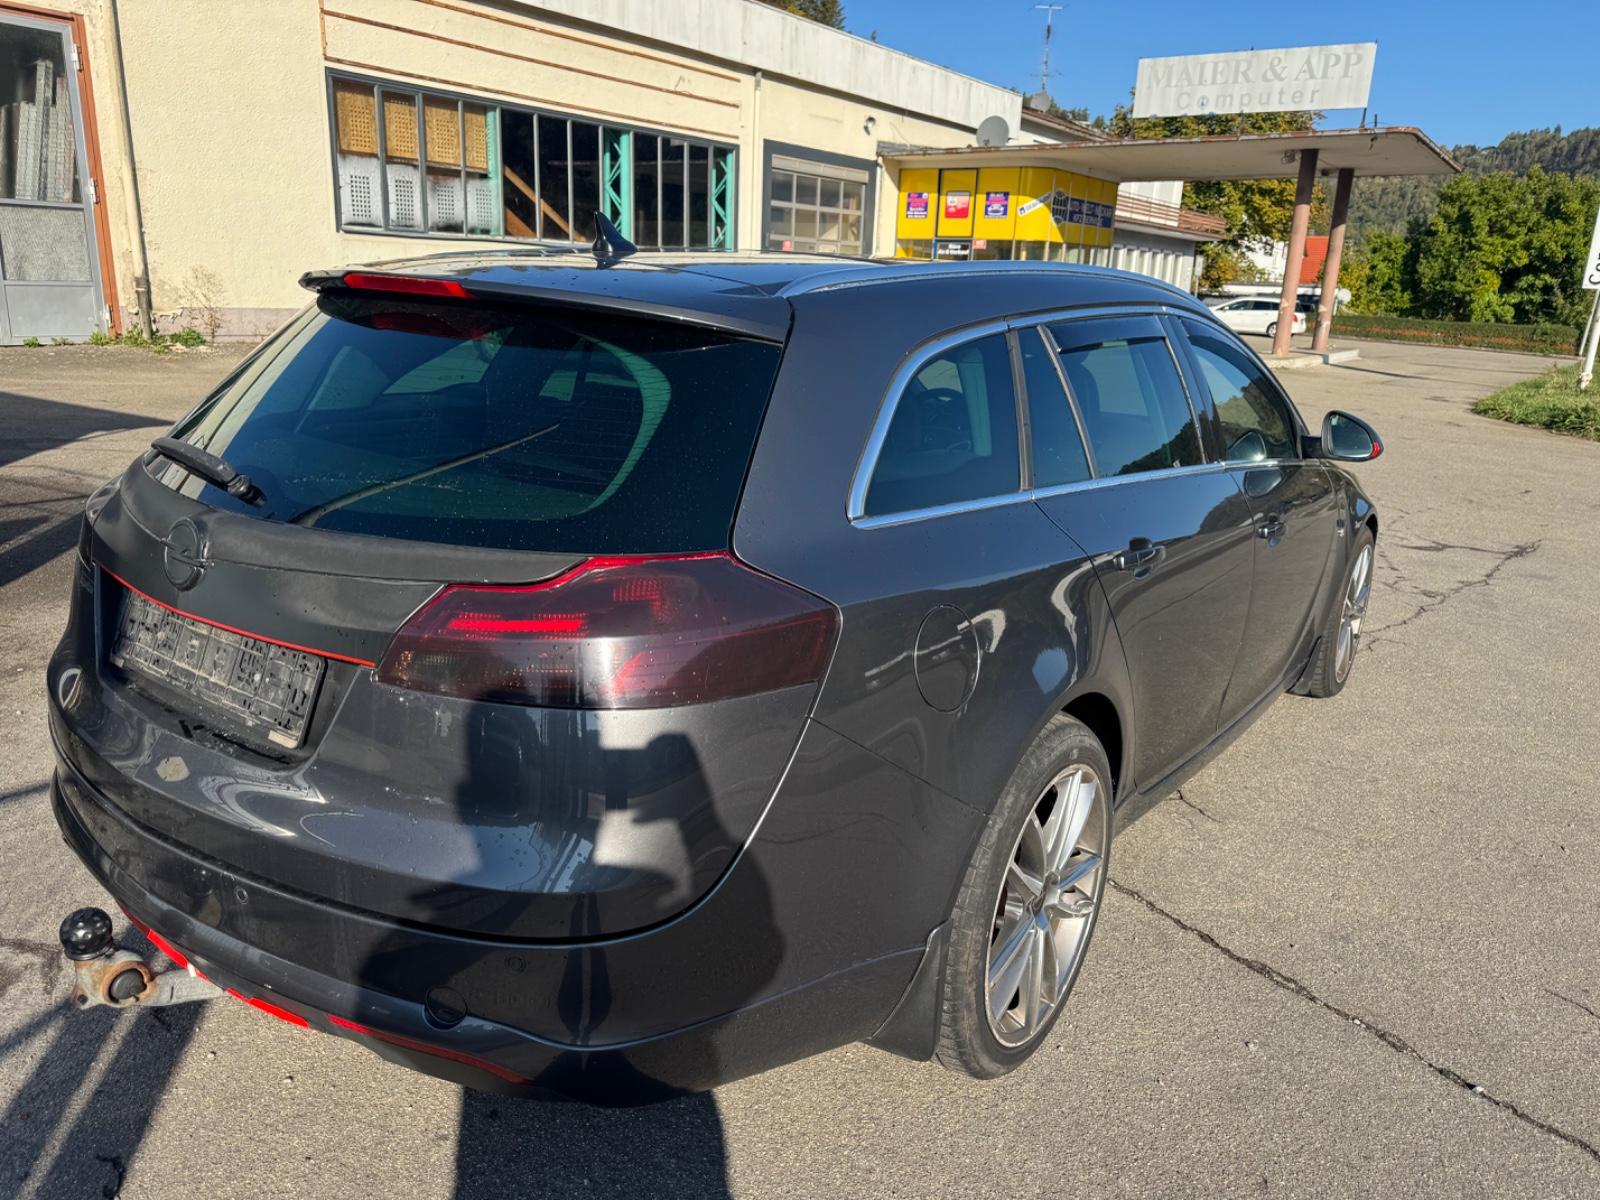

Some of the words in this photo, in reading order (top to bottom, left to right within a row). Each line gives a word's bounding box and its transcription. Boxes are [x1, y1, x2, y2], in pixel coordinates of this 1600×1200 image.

[1147, 59, 1255, 89] MAIER
[1261, 55, 1288, 83] &
[1295, 52, 1363, 81] APP
[1176, 88, 1320, 110] Computer
